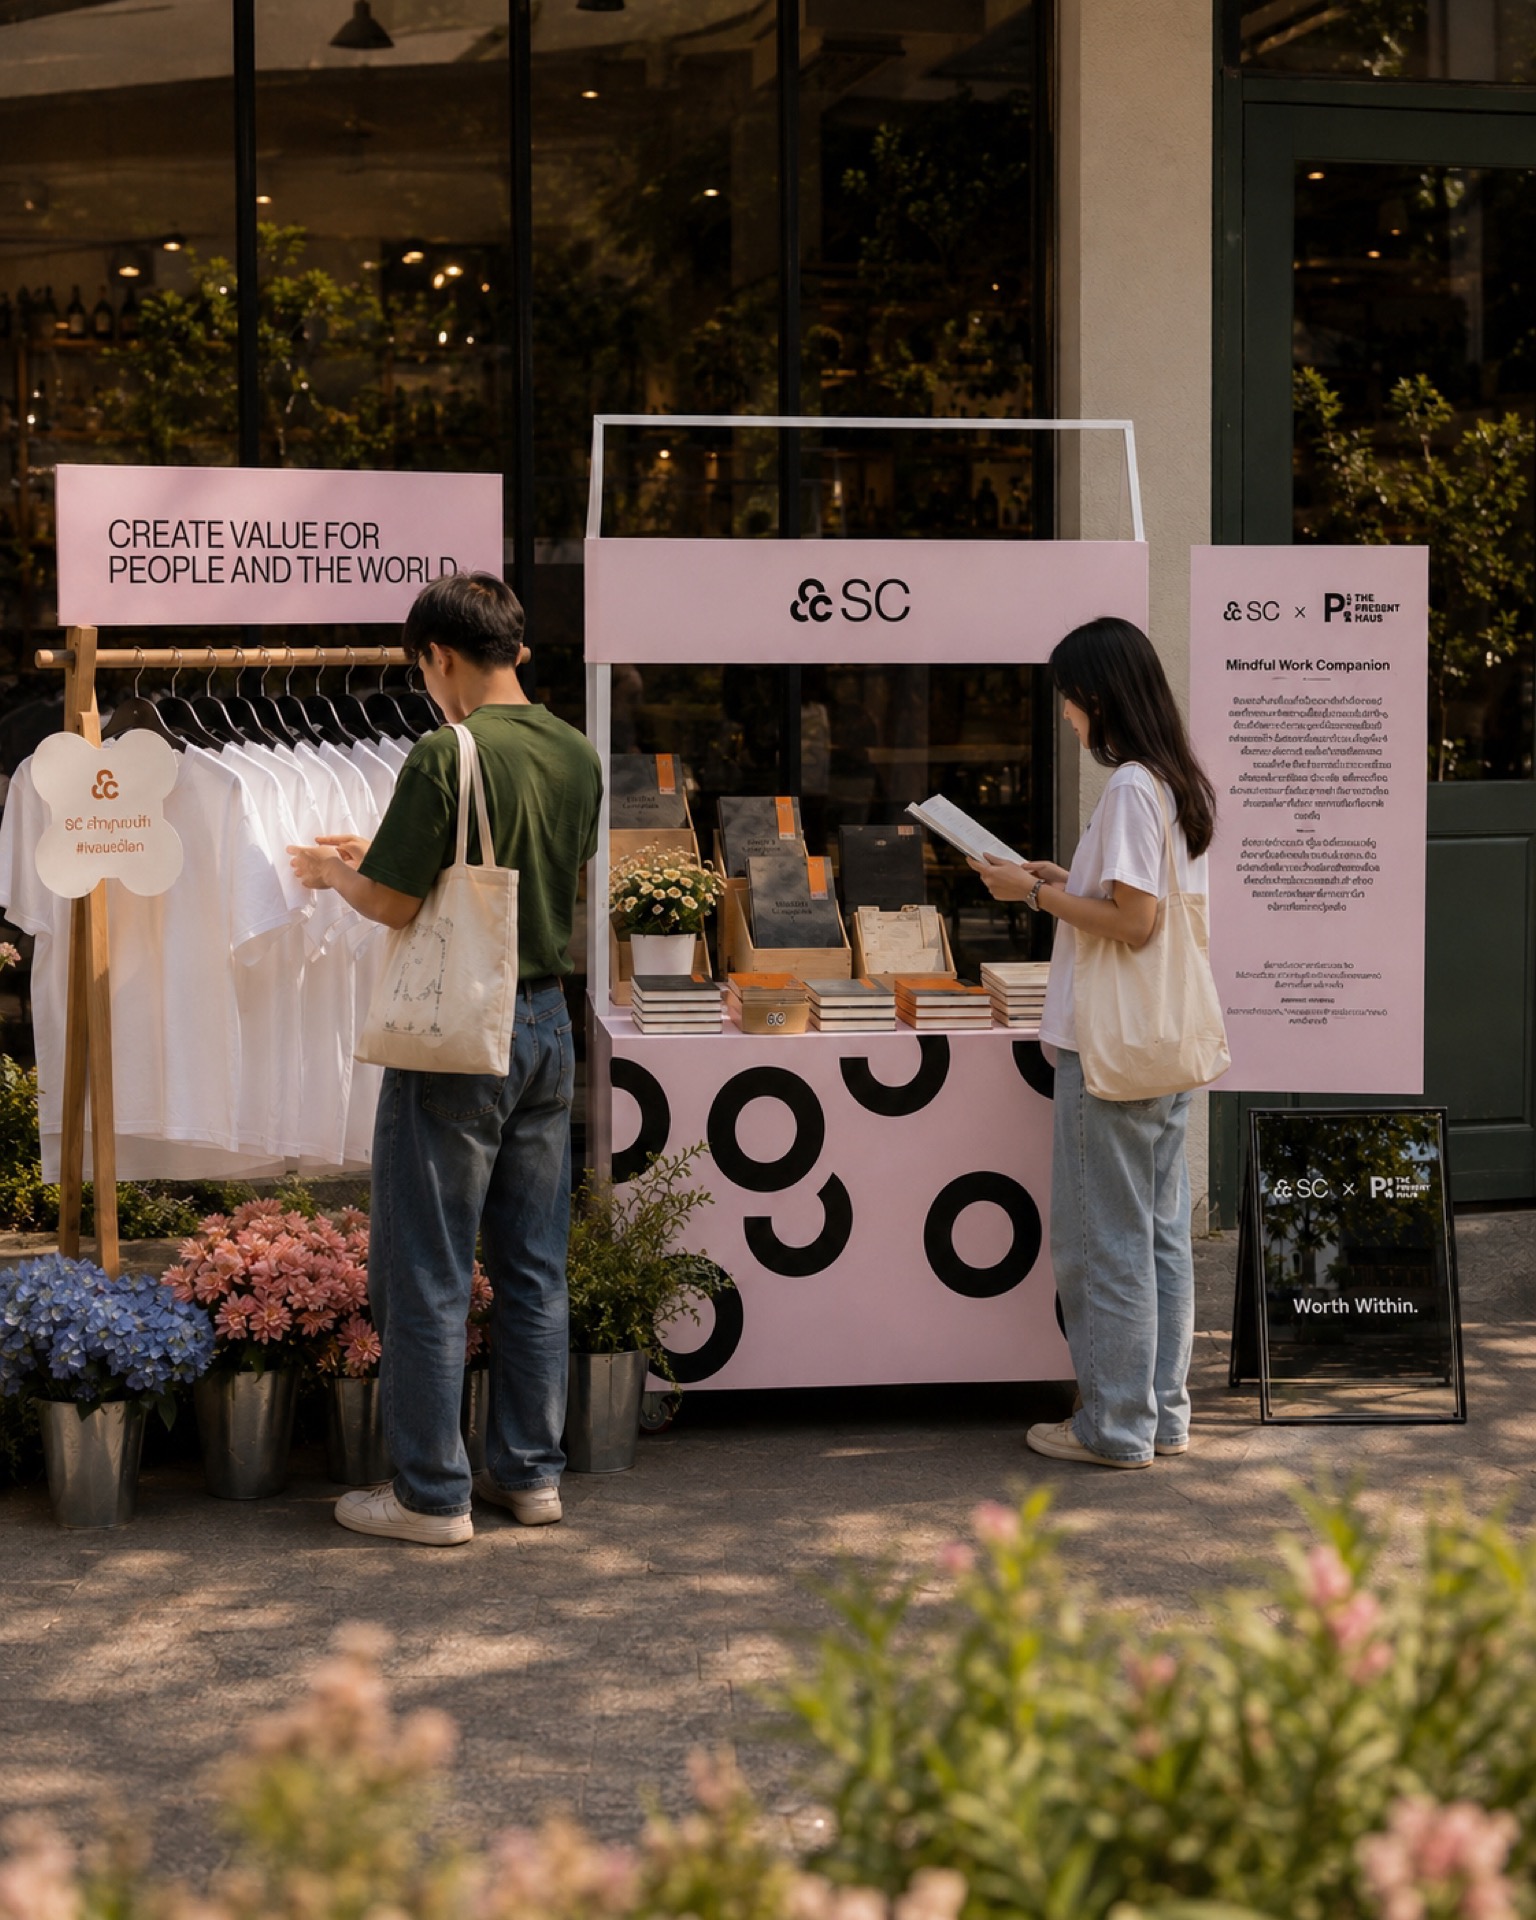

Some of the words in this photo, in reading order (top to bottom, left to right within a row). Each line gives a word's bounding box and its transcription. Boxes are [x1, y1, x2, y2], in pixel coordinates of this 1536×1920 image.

[108, 519, 224, 549] CREATE
[229, 521, 319, 550] VALUE
[325, 522, 380, 550] FOR
[109, 556, 225, 584] PEOPLE
[230, 556, 292, 584] AND
[297, 556, 353, 584] THE
[357, 556, 458, 584] WORLD
[1354, 593, 1375, 602] THE
[1354, 613, 1384, 623] HAUS
[1226, 659, 1276, 671] Mindful
[1278, 659, 1314, 671] Work
[1316, 659, 1391, 674] Companion
[1293, 1298, 1350, 1314] Worth
[1354, 1297, 1419, 1314] Within.
